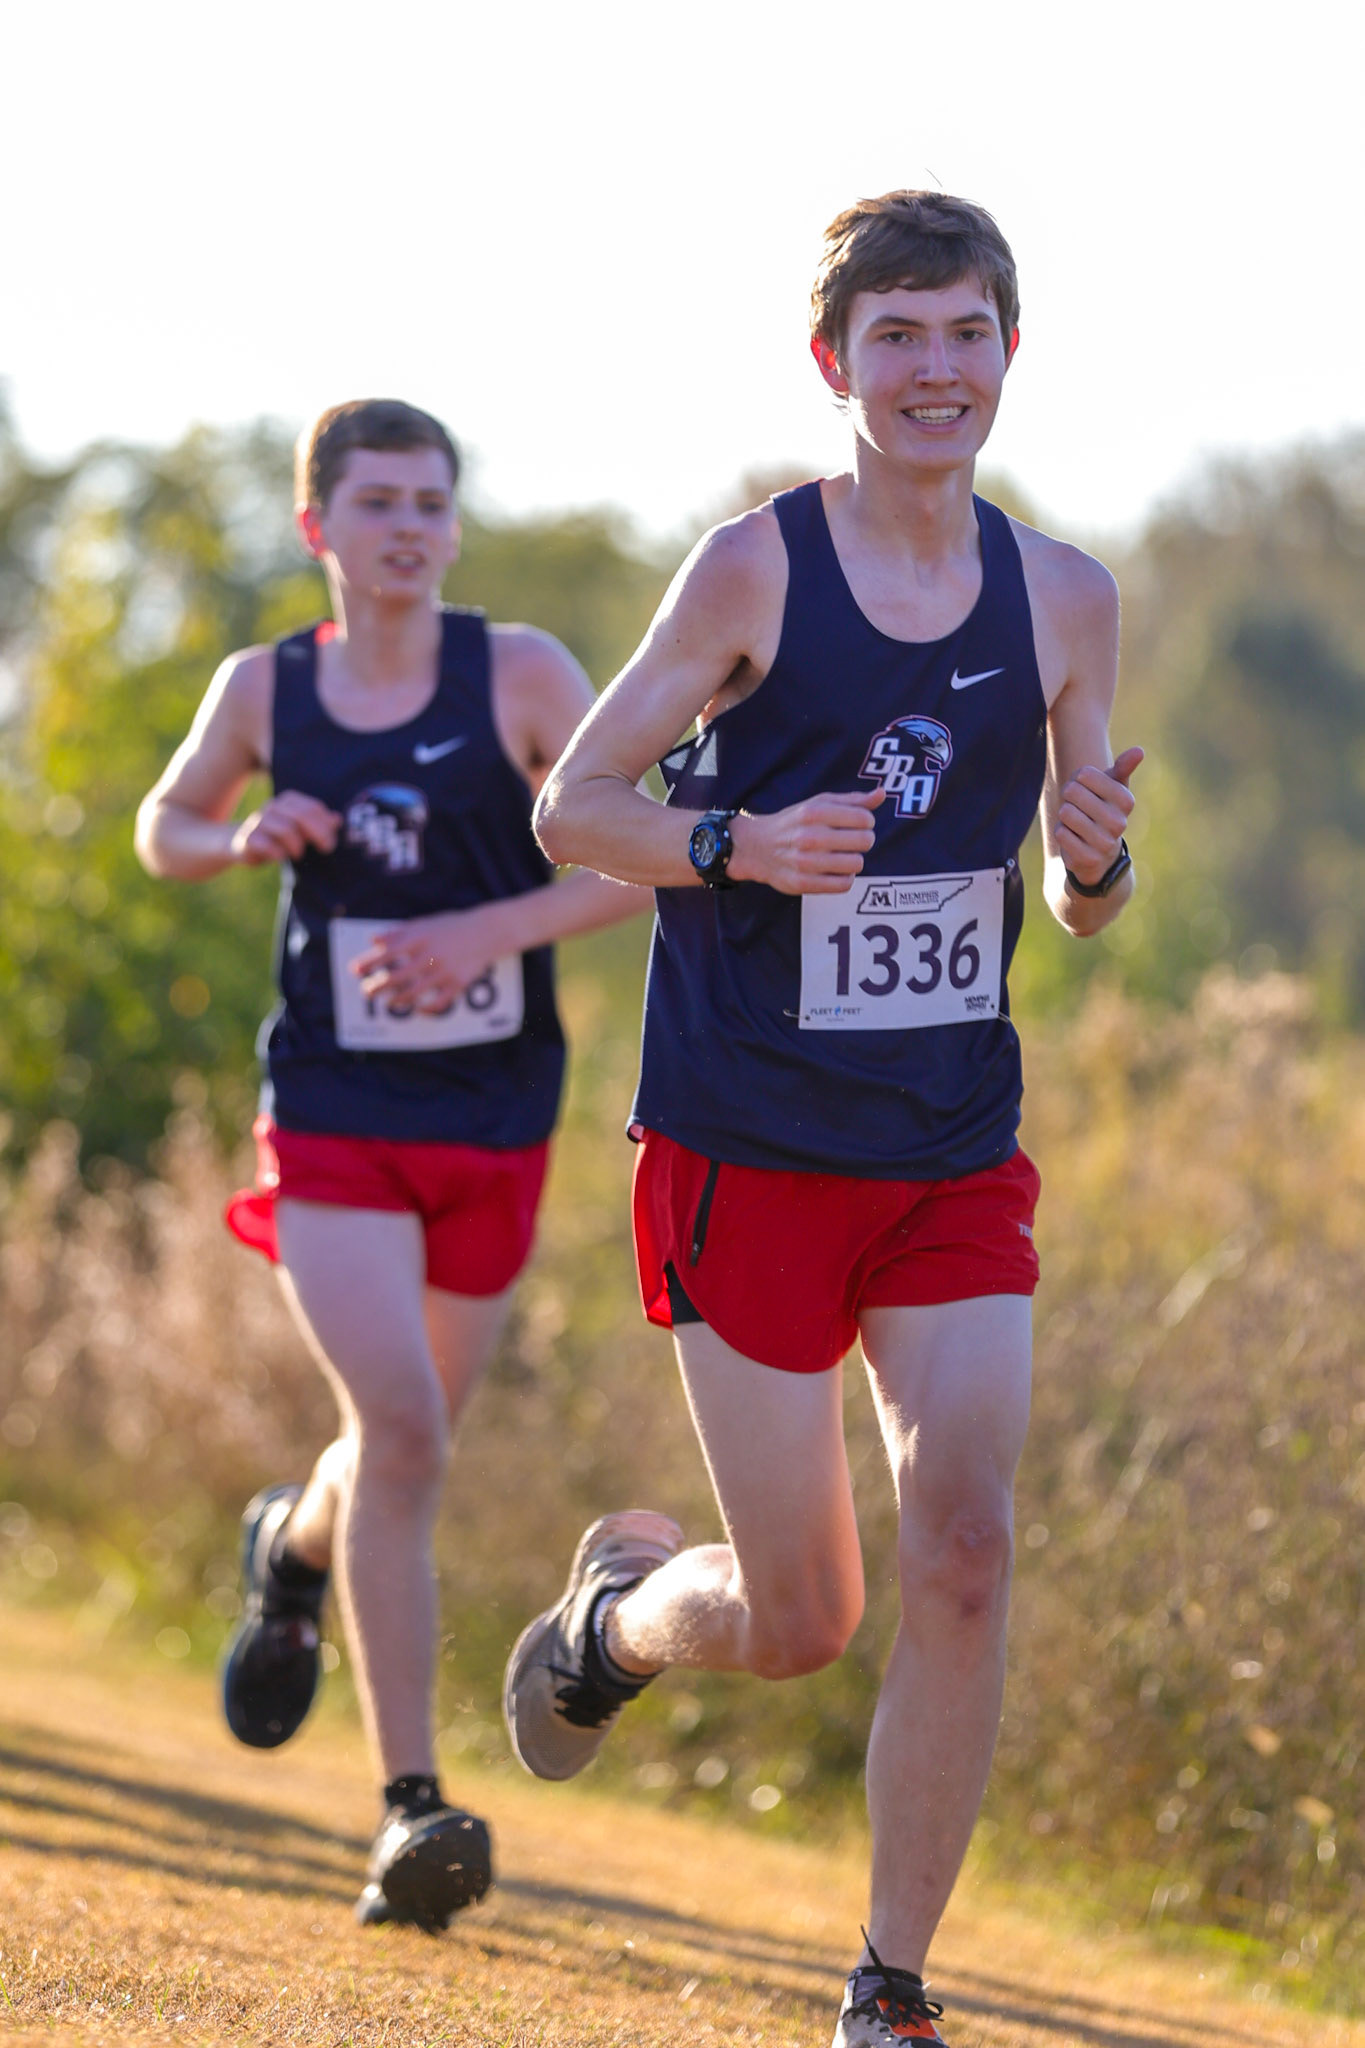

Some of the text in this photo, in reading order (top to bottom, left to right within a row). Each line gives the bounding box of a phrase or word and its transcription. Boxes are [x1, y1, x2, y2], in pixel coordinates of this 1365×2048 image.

[865, 737, 936, 814] SBA
[869, 891, 892, 907] M
[828, 918, 980, 997] 1336
